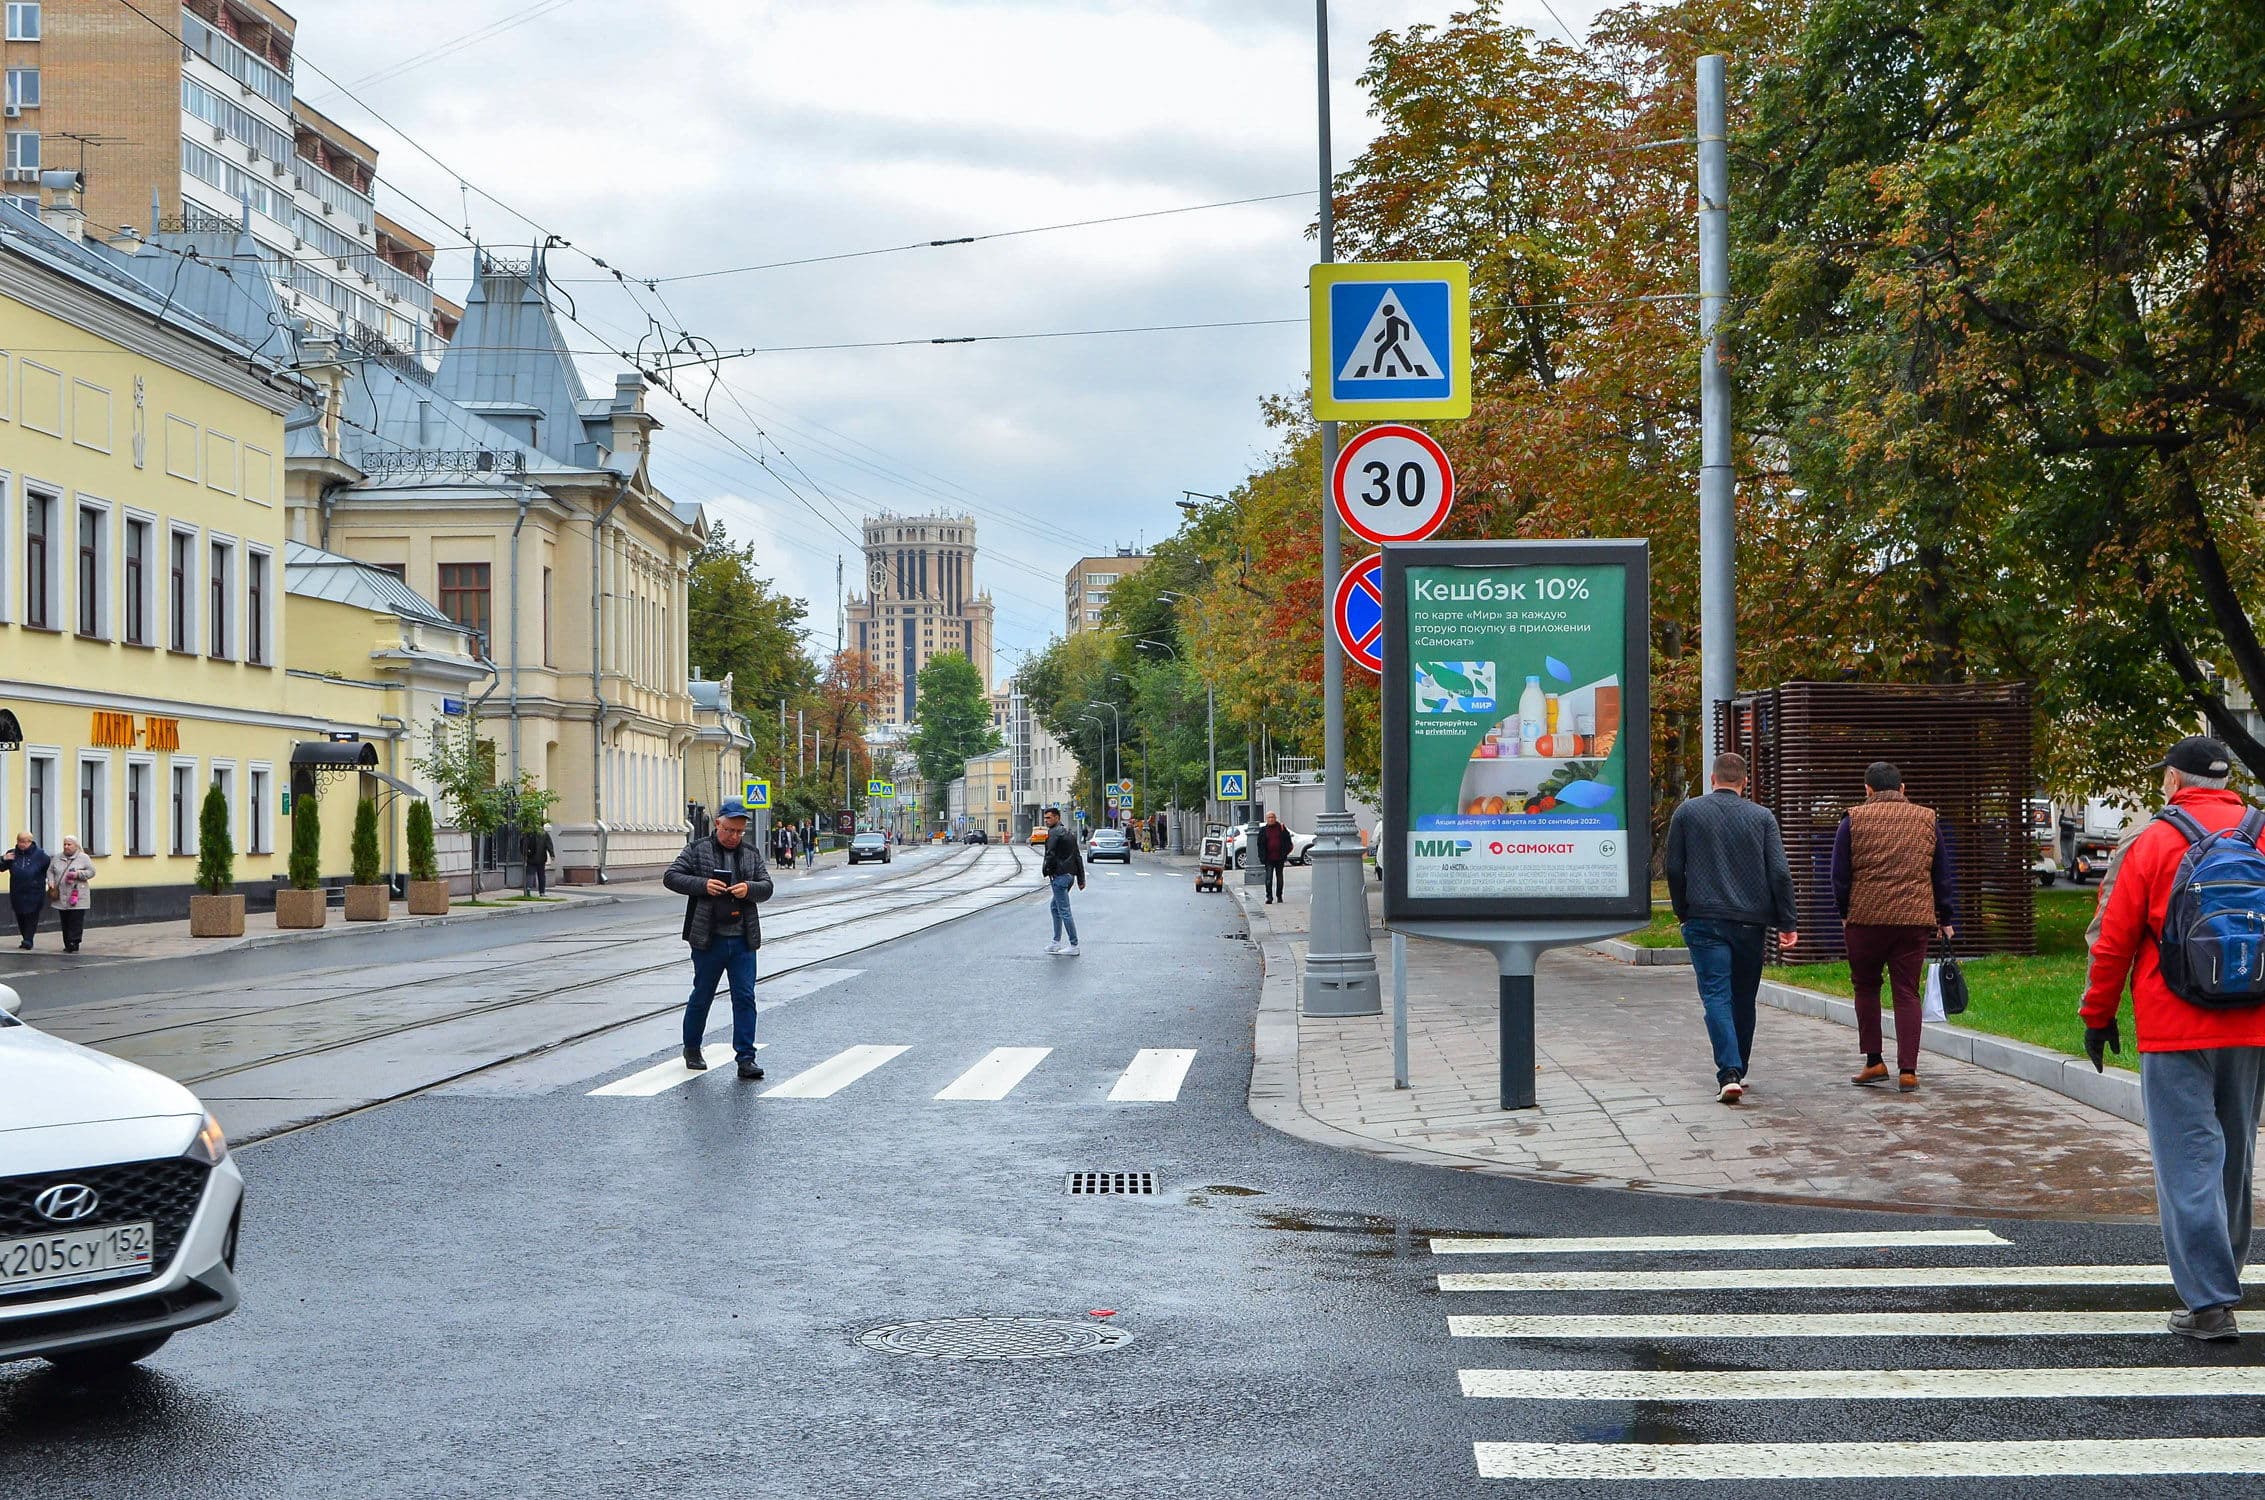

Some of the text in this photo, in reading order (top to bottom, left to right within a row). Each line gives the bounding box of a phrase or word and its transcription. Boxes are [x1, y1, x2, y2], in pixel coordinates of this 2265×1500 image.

[1361, 461, 1425, 507] 30
[1414, 578, 1590, 601] Кешбэк 10%
[1414, 611, 1567, 621] по карте «Мир» за каждую
[1415, 624, 1591, 634] вторую покупку в приложении
[1415, 637, 1475, 646] «Самокат»
[1471, 702, 1492, 710] МИР
[1415, 720, 1478, 728] Регистрируйтесь
[1548, 818, 1579, 826] сентября
[1414, 839, 1472, 857] МИР
[1506, 843, 1575, 854] самокат
[1602, 844, 1614, 852] 6+
[107, 1227, 145, 1253] 152
[116, 1252, 135, 1262] RUS
